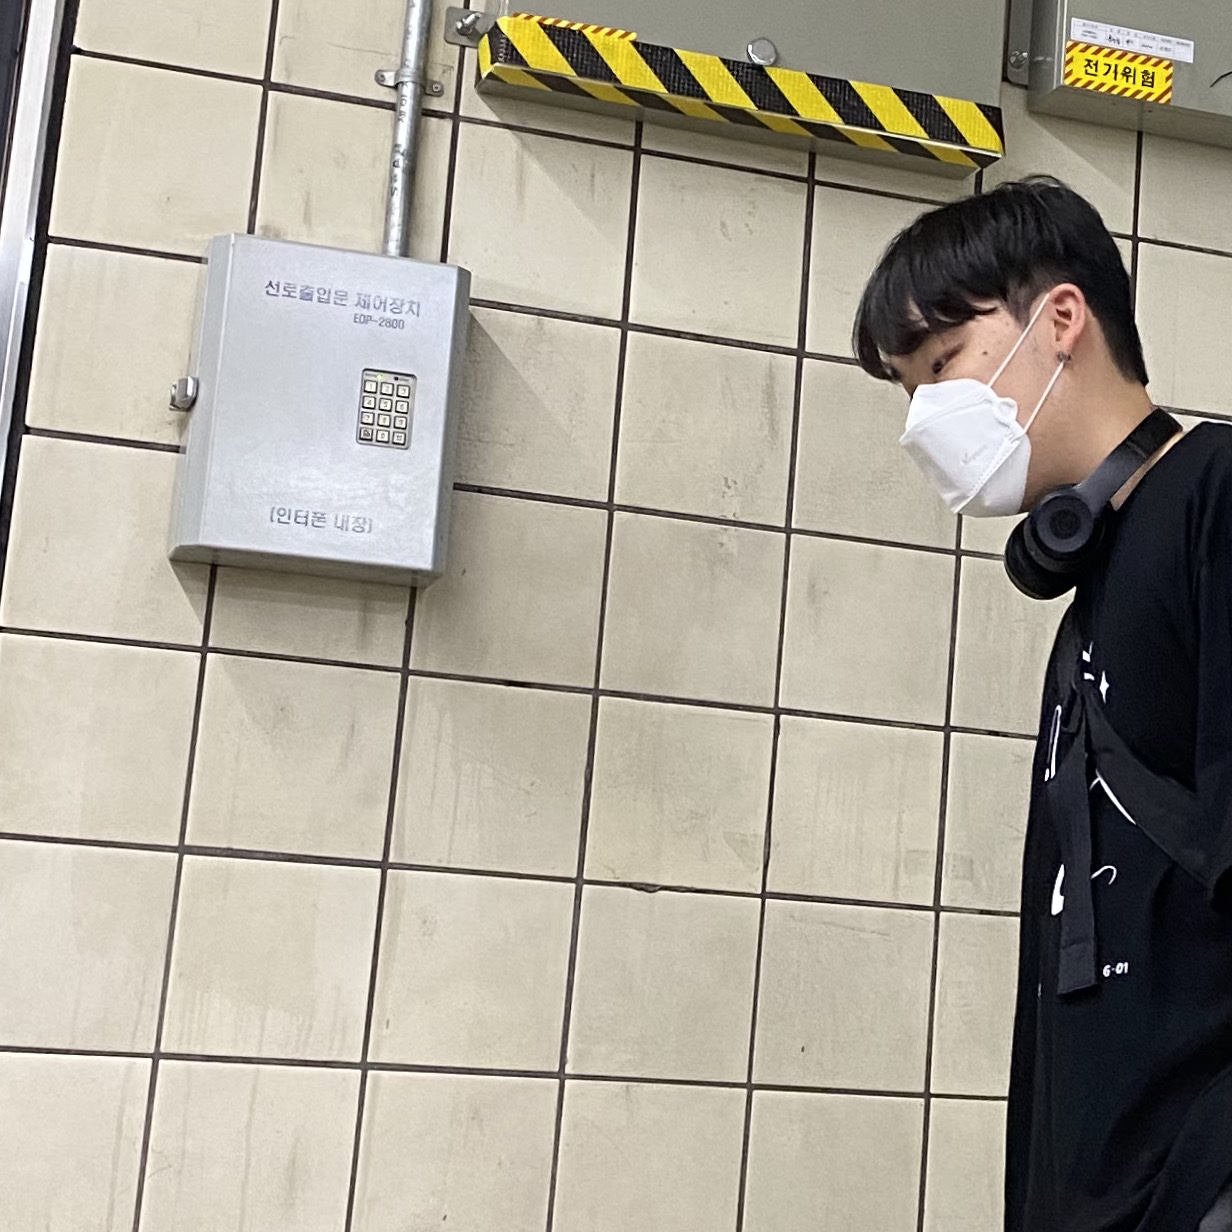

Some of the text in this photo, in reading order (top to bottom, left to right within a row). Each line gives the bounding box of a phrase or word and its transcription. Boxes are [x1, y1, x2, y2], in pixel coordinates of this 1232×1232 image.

[1083, 58, 1155, 89] 전기위험
[264, 279, 421, 318] 선로출입문 제어장치
